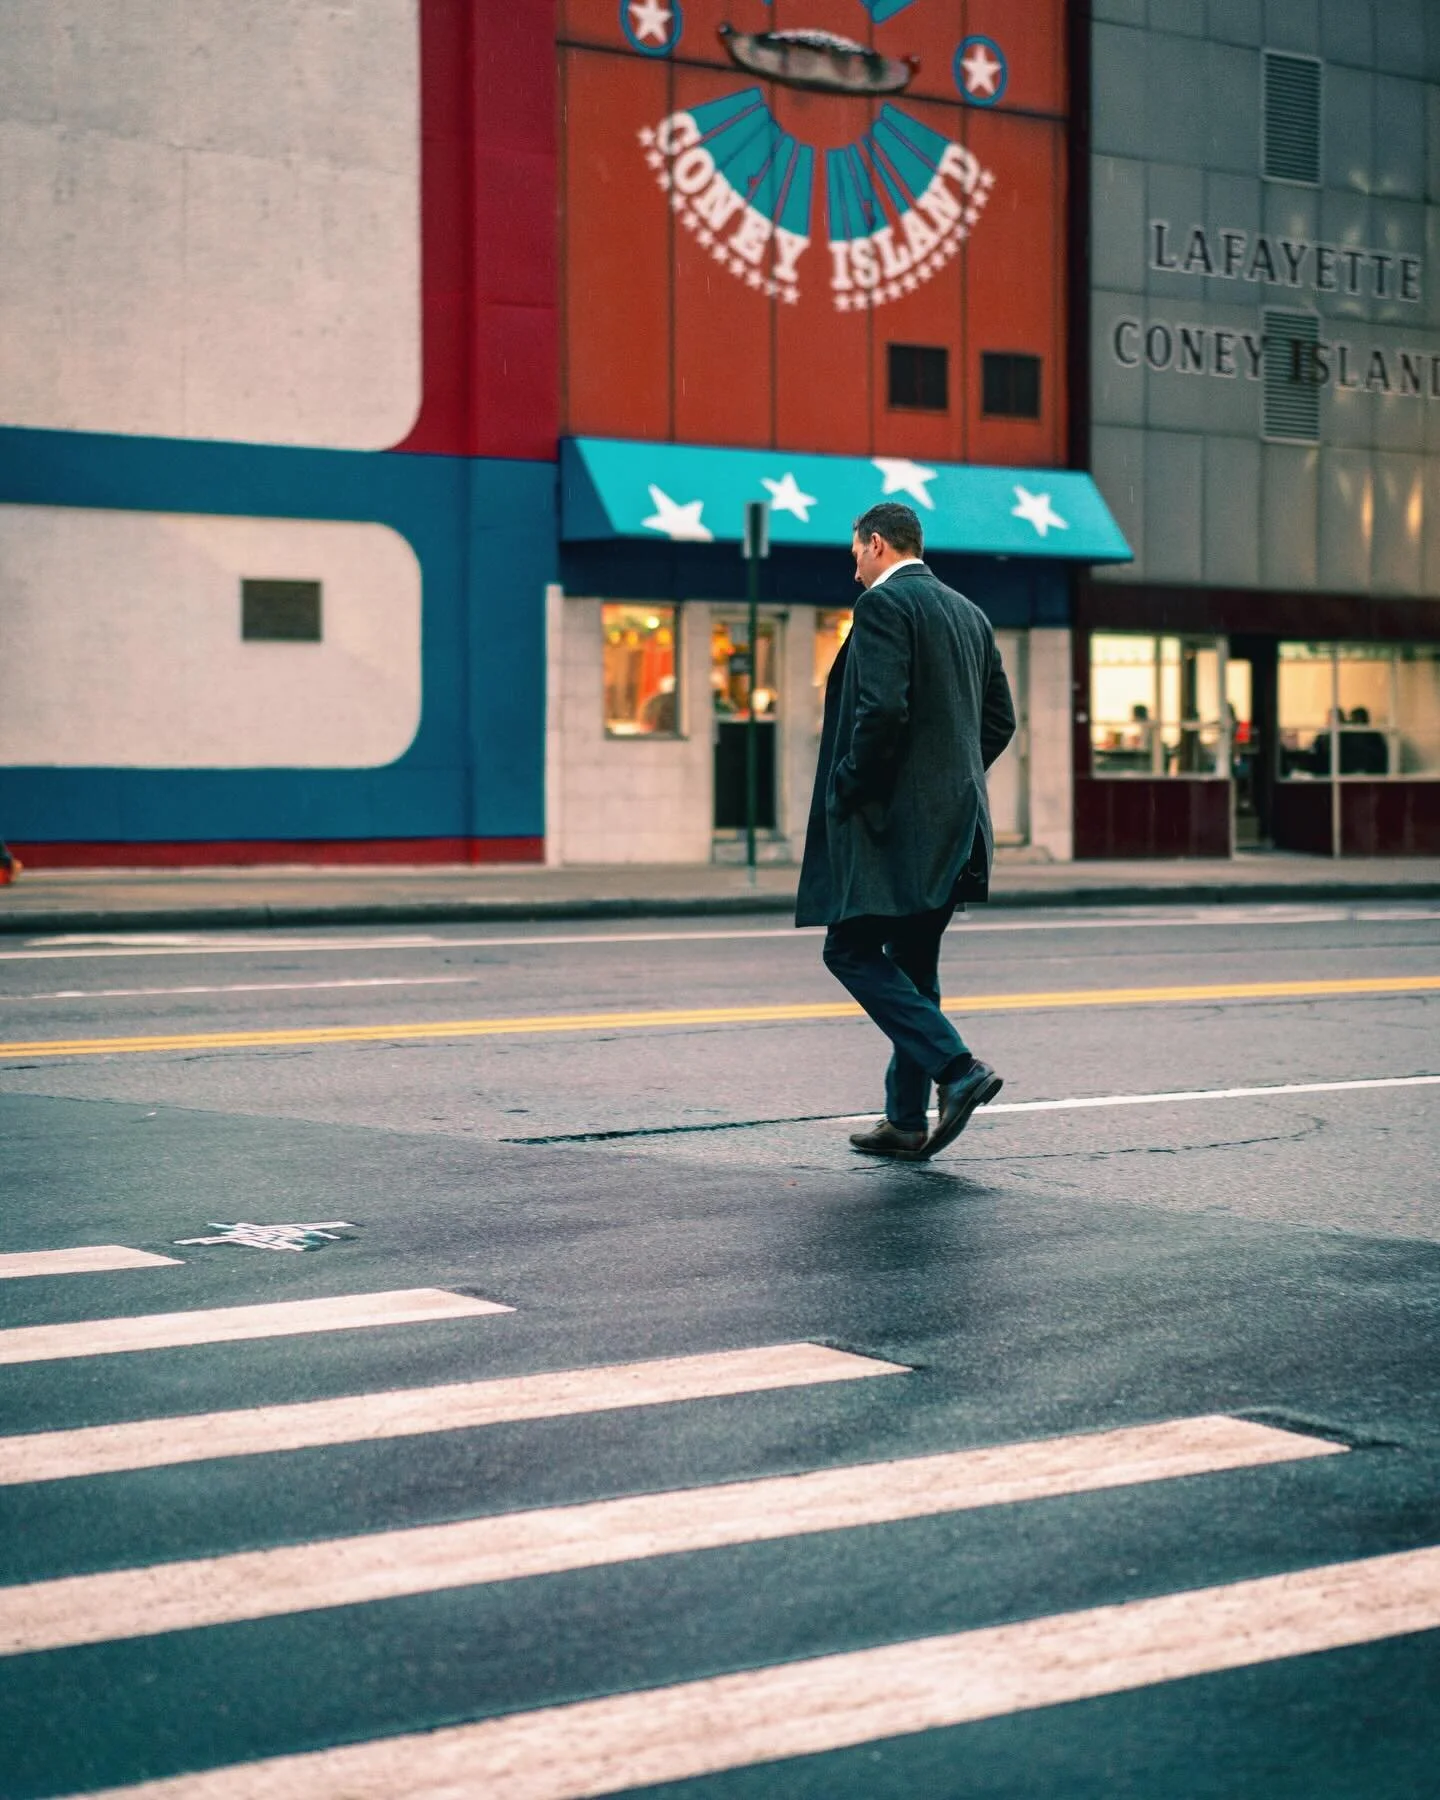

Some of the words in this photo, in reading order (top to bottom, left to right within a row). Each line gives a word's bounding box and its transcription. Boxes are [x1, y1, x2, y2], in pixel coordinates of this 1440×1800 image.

[656, 111, 811, 283] CONEY
[828, 143, 978, 290] ISLAND
[1150, 220, 1422, 302] LAFAYETTE
[1113, 318, 1269, 380] CONEY
